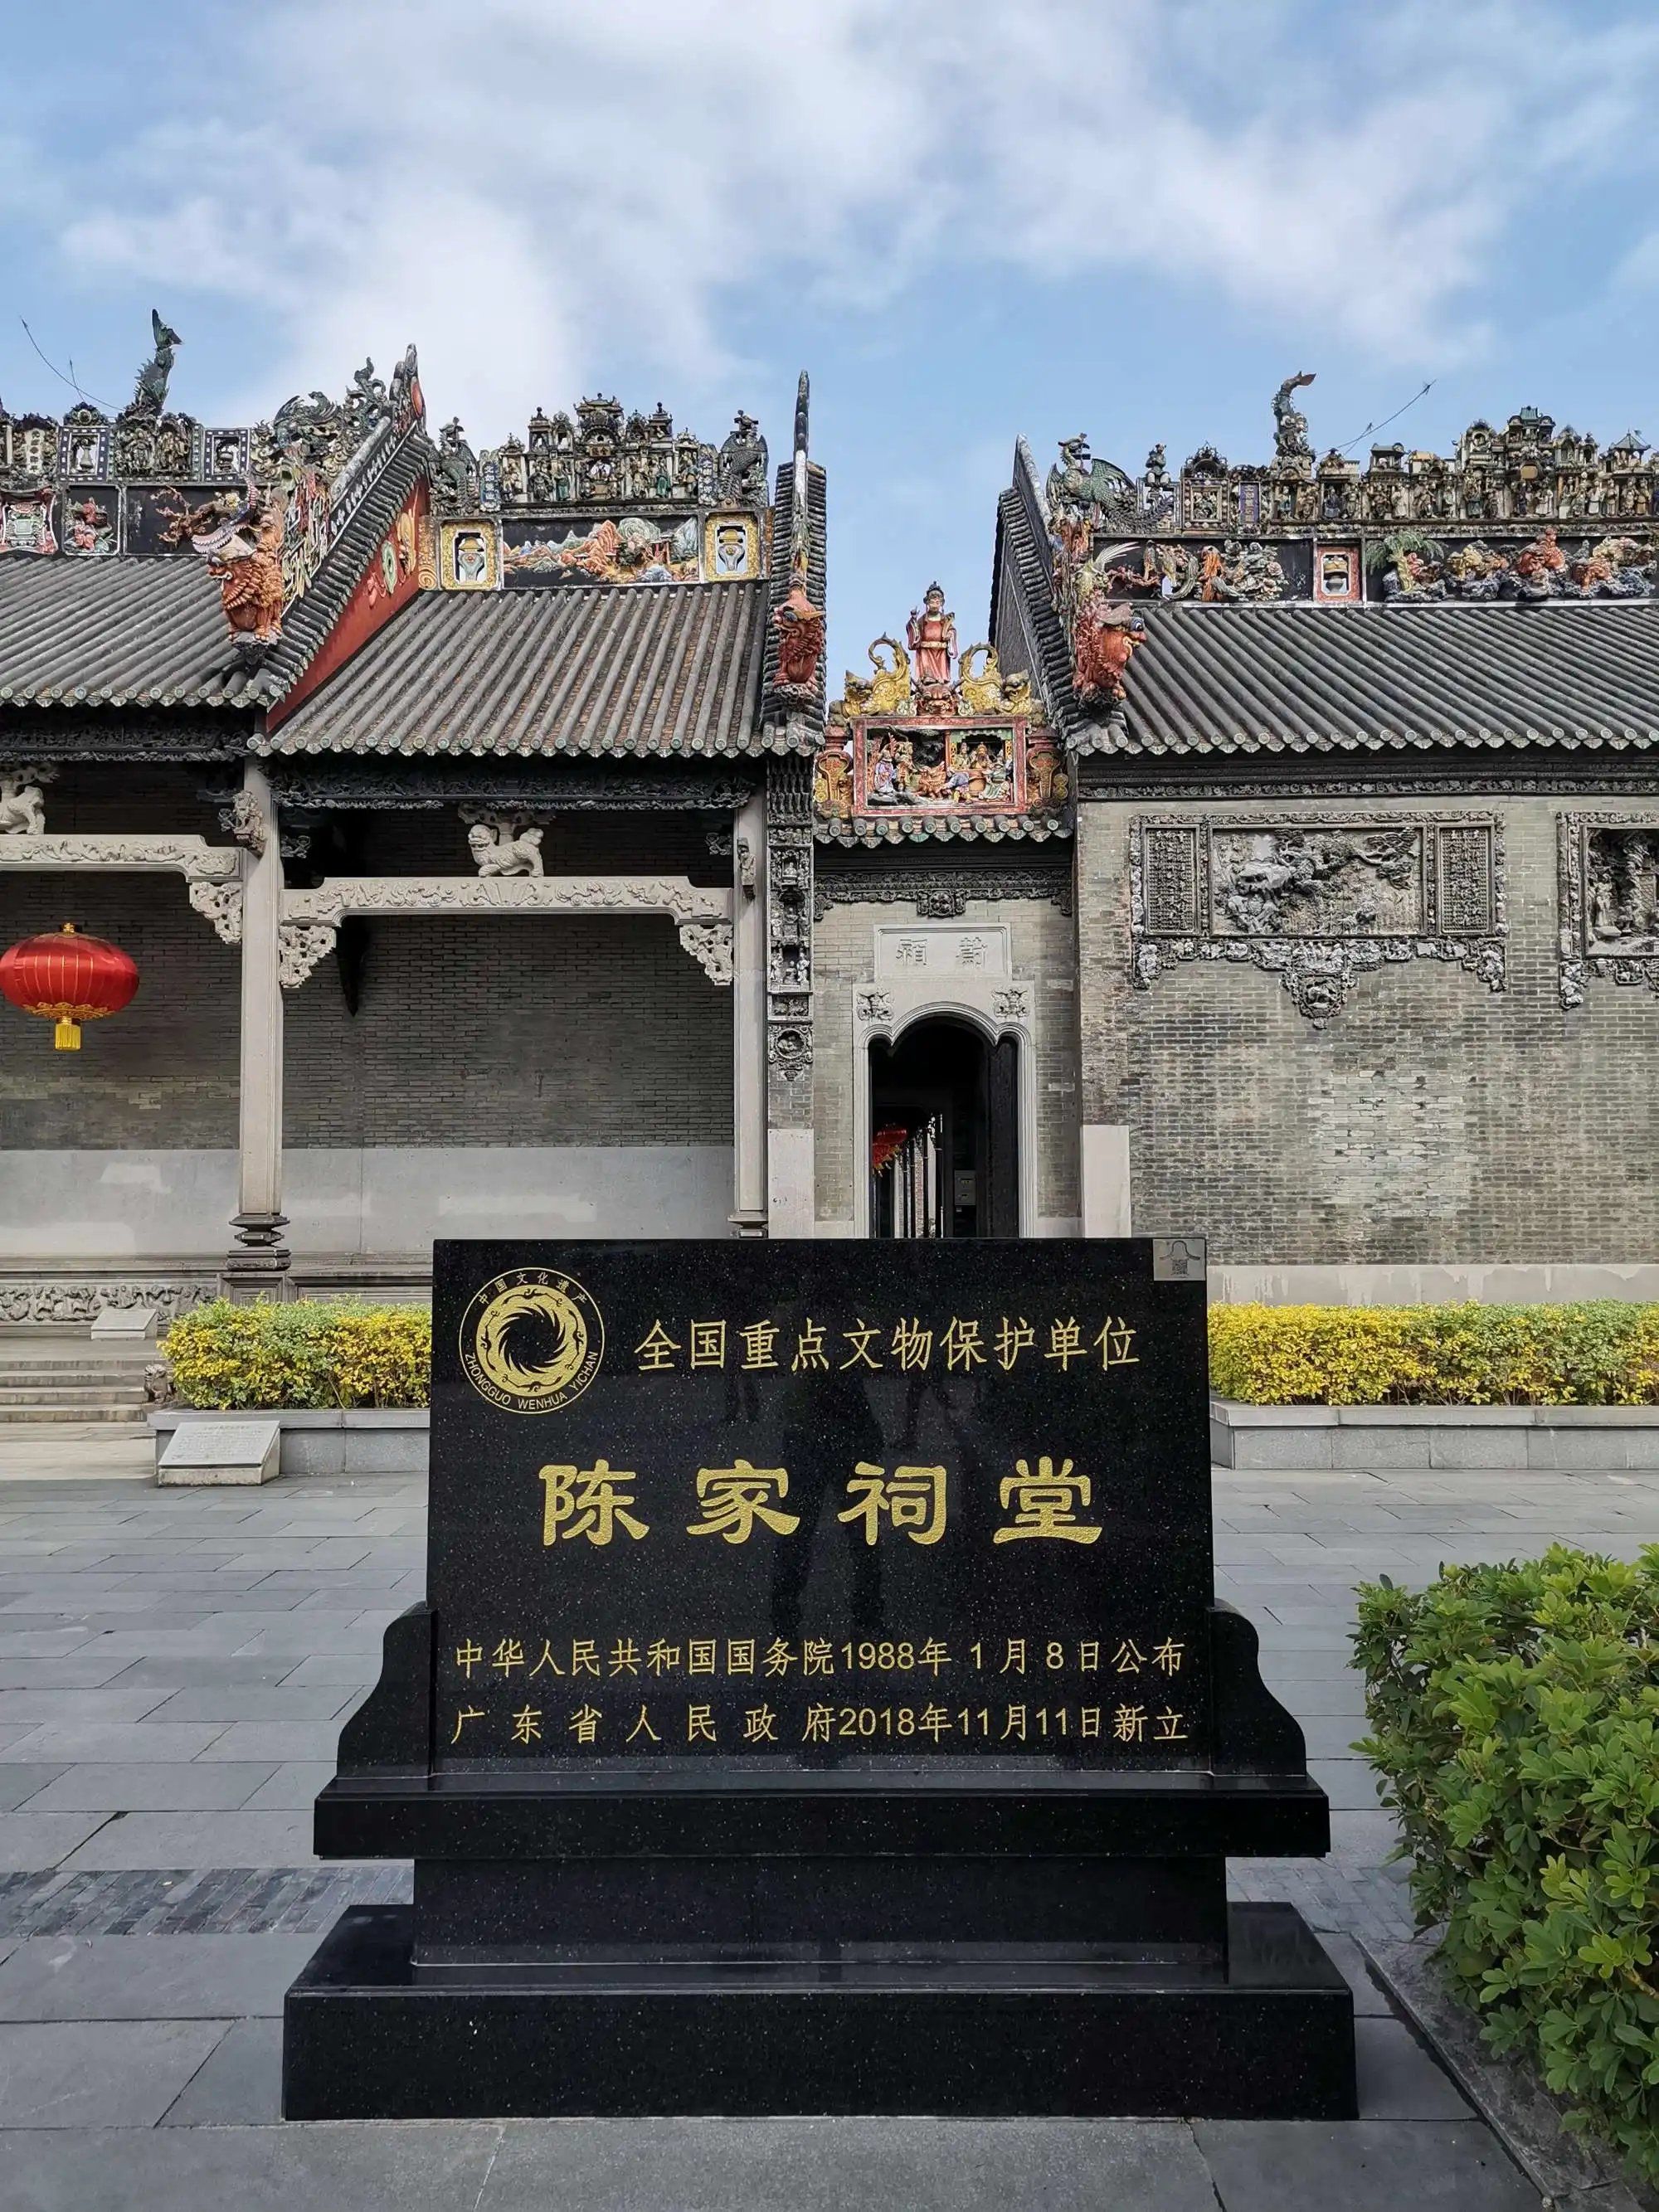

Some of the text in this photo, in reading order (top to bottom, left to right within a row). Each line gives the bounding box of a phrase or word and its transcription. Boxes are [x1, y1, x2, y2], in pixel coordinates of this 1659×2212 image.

[634, 1315, 1140, 1372] 全国重点文物保护单位
[465, 1351, 599, 1411] ZHONGGUO WENHUA YICHAN
[538, 1456, 1103, 1546] 陈家祠堂
[450, 1703, 1188, 1744] 广东省人民政府2018年11月11日新立
